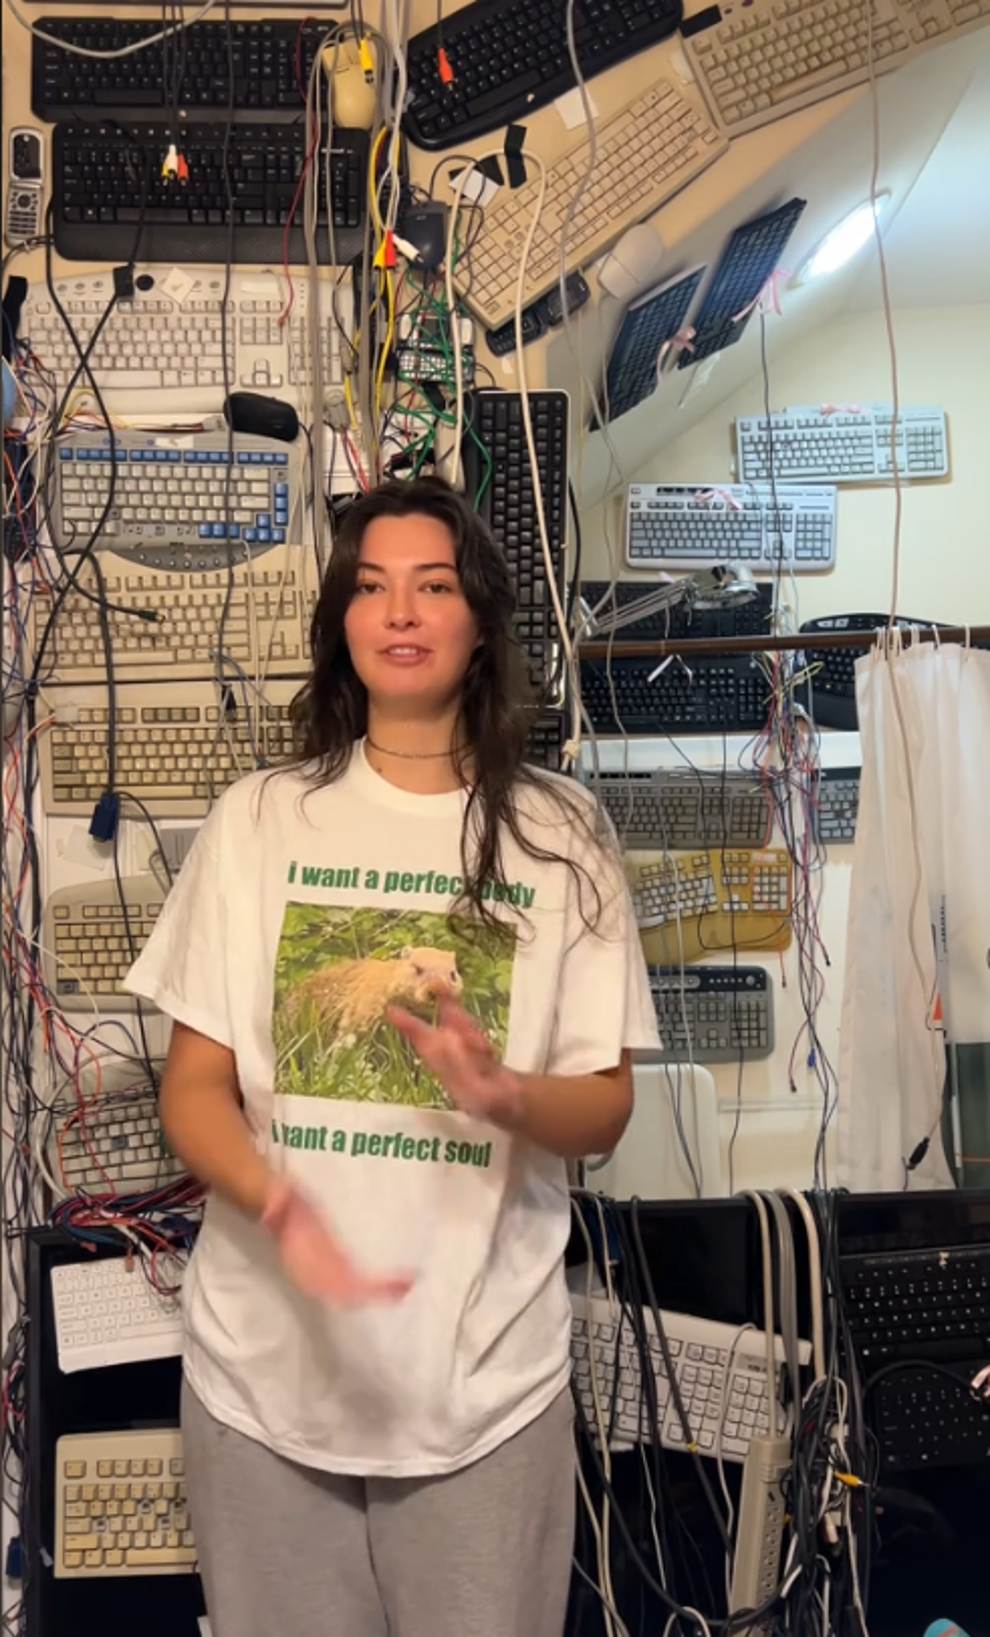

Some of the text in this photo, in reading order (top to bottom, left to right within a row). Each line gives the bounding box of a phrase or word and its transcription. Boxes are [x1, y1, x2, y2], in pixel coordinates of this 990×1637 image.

[288, 861, 297, 883] i
[301, 866, 360, 888] want
[364, 869, 379, 889] a
[383, 870, 468, 896] perfec
[272, 1118, 279, 1143] i
[332, 1130, 346, 1152] a
[351, 1132, 440, 1162] perfect
[445, 1140, 492, 1168] soul
